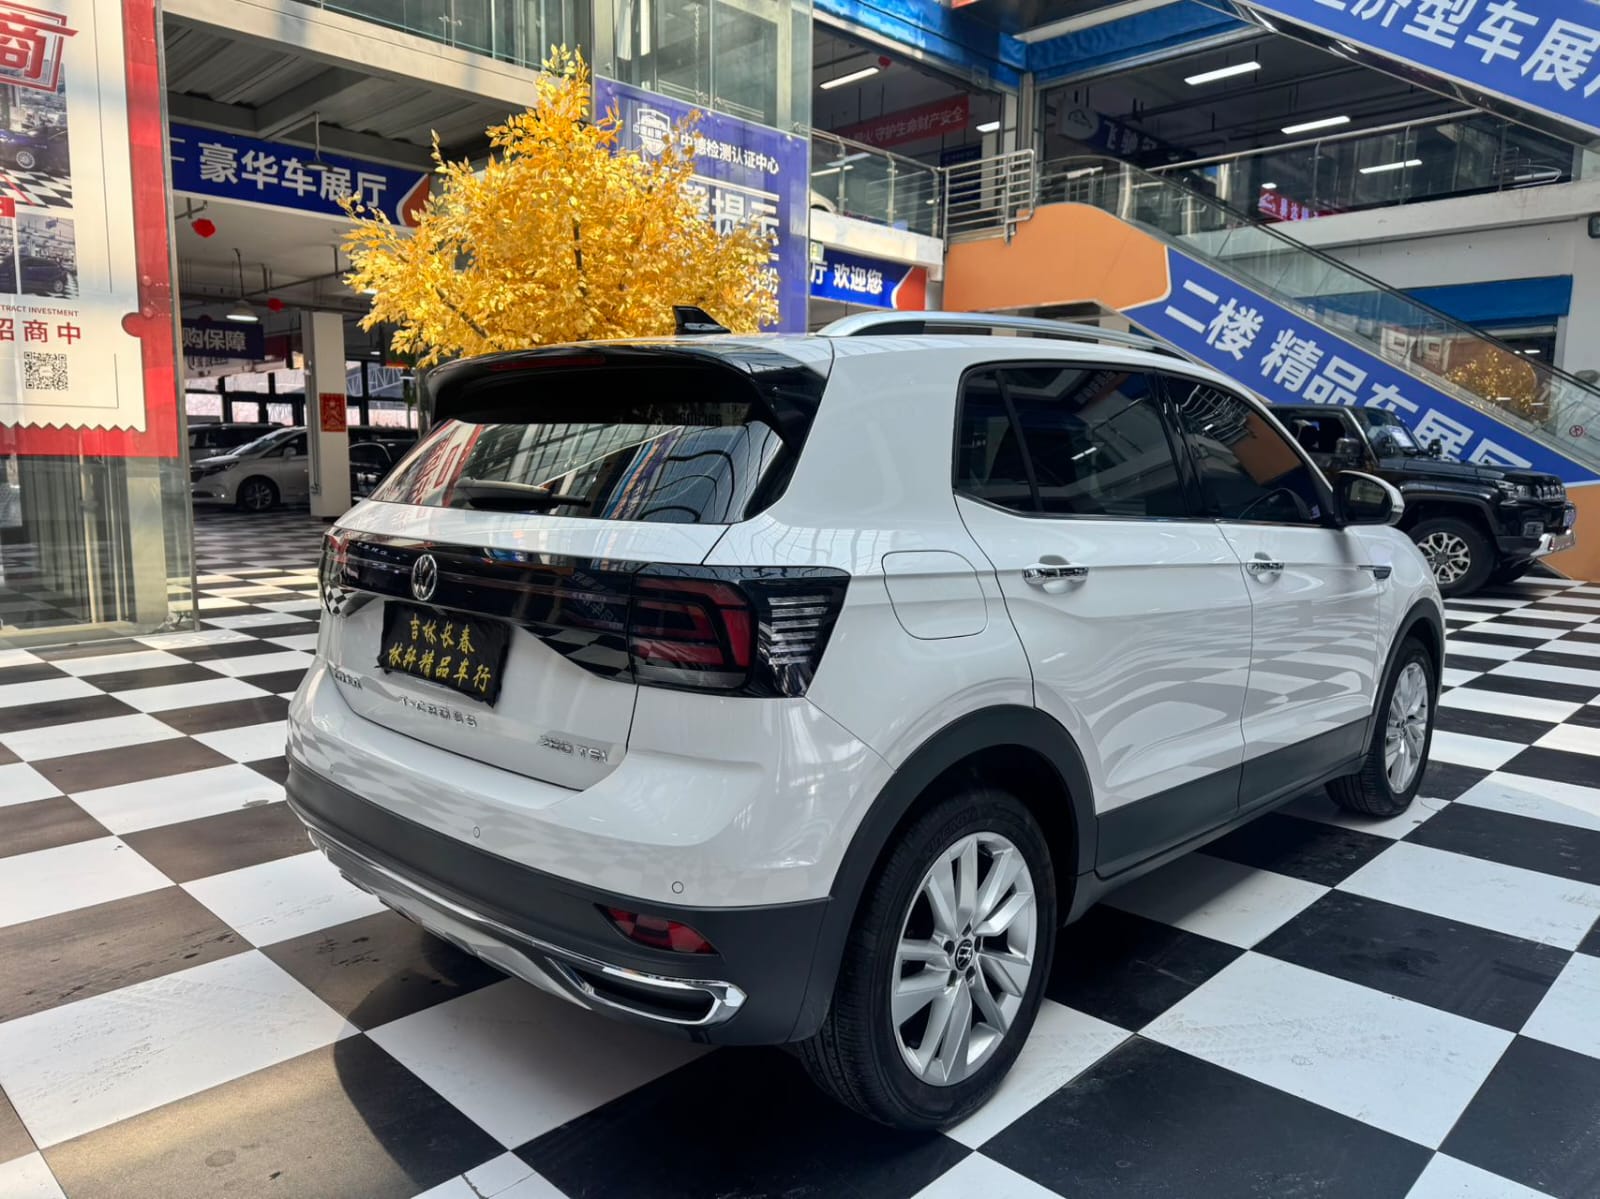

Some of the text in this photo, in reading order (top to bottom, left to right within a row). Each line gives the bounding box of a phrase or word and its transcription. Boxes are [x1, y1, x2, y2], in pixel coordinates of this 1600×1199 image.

[198, 142, 387, 208] 豪华车展厅
[833, 263, 884, 295] 欢迎您
[28, 306, 79, 317] INVESTMENT
[1165, 279, 1264, 361] 二楼
[409, 612, 475, 655] 吉林长春
